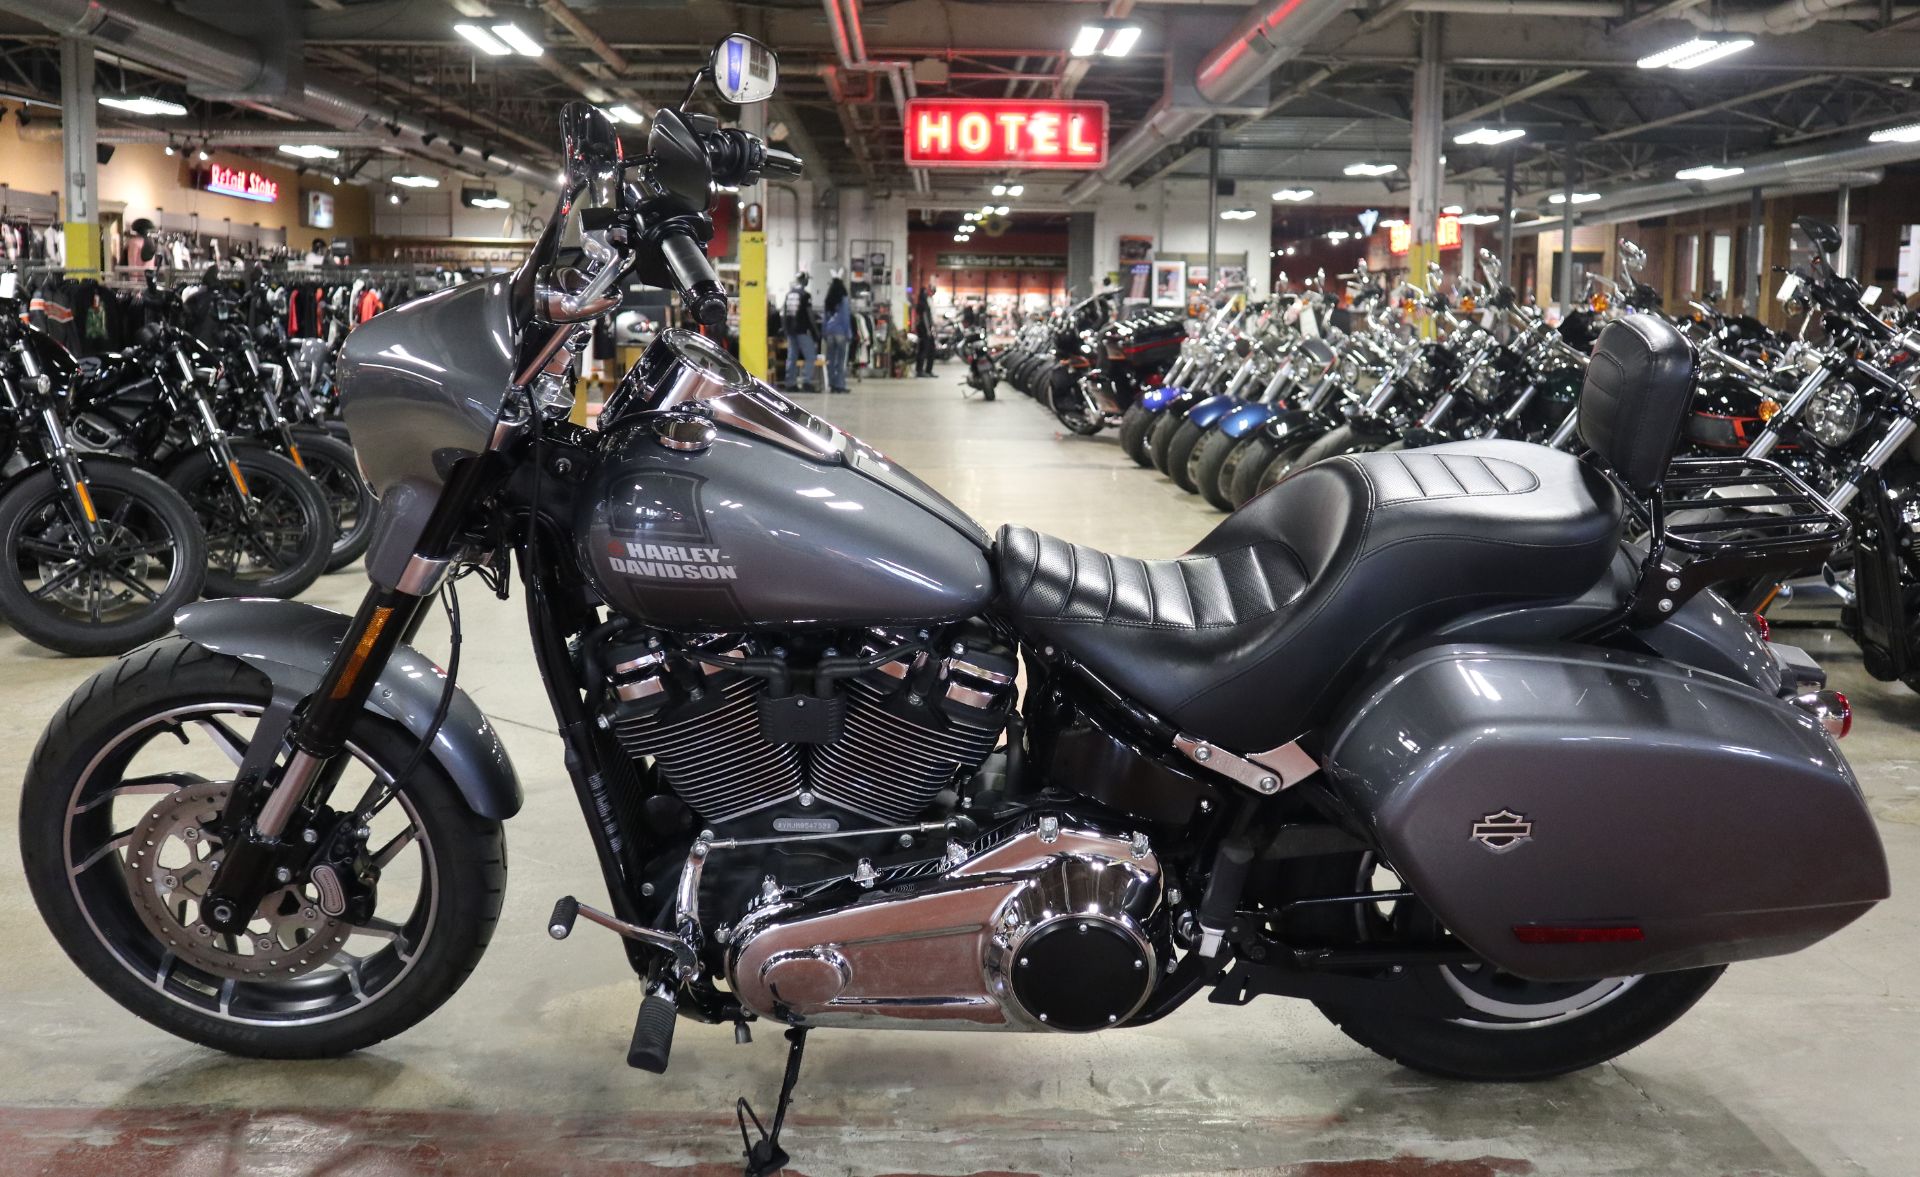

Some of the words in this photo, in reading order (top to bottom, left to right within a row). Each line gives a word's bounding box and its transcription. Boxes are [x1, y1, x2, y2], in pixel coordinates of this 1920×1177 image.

[917, 110, 1097, 156] HOTEL
[625, 542, 731, 563] HARLEY-
[608, 556, 738, 580] DAVIDSON
